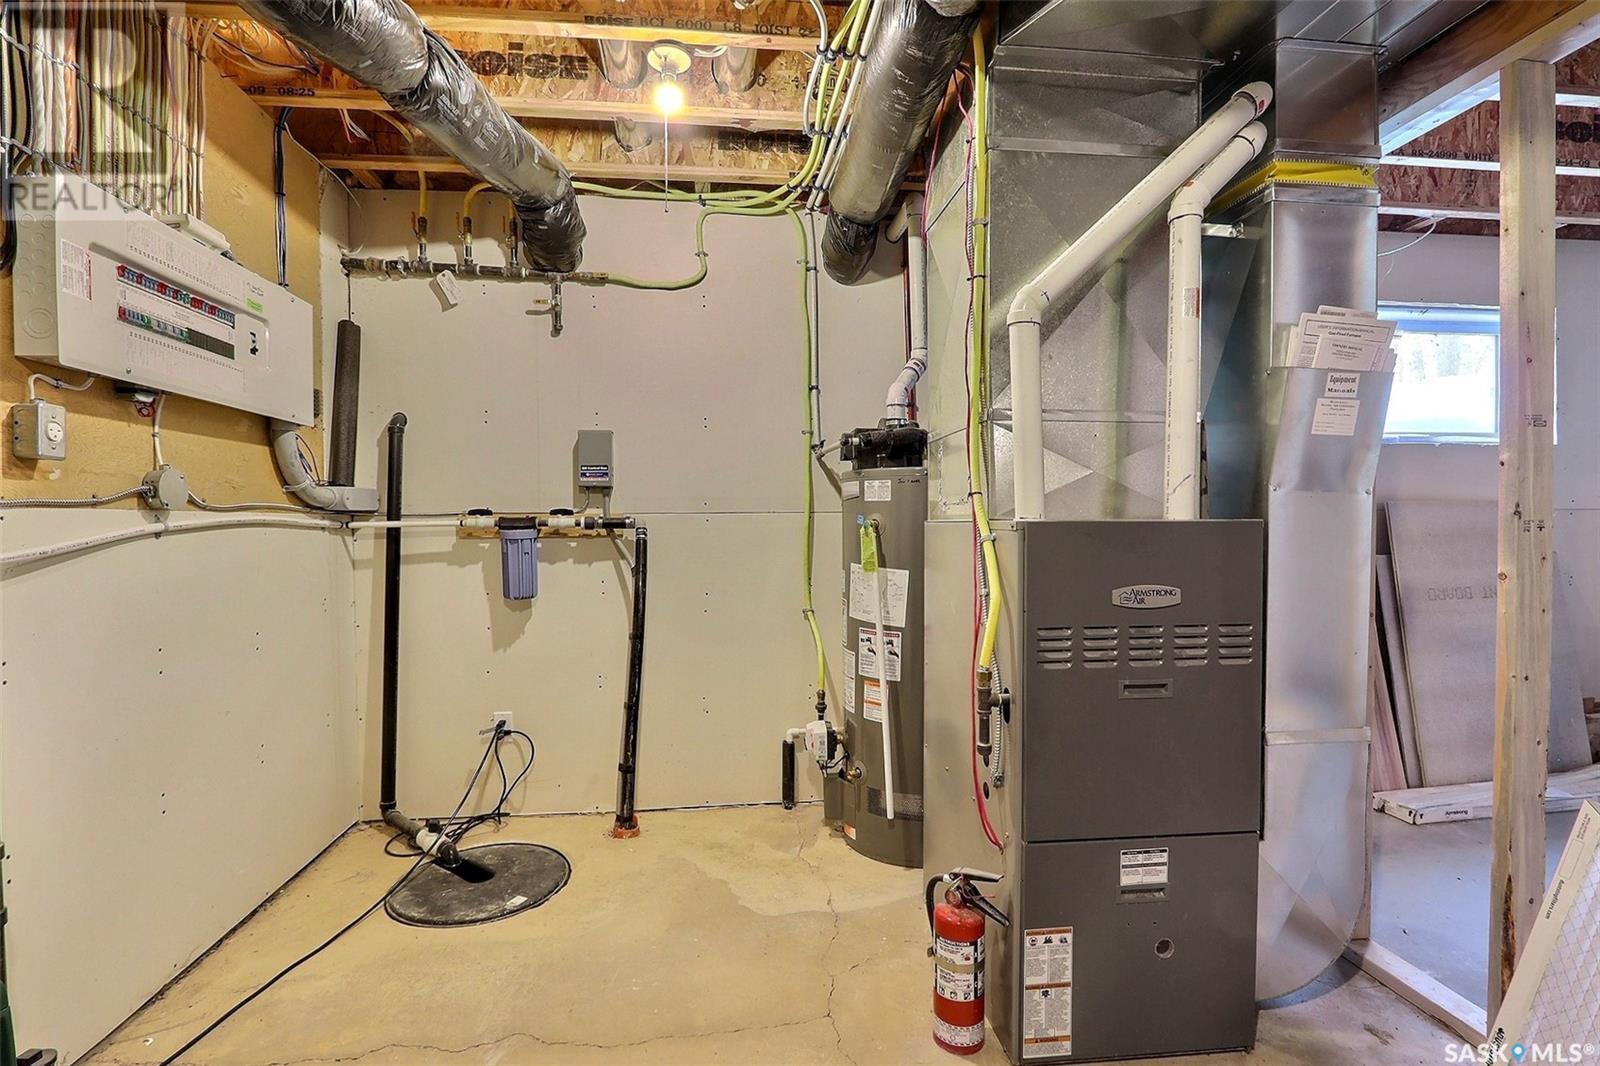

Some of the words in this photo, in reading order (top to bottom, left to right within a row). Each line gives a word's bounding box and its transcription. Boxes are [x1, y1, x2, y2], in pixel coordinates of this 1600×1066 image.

[676, 19, 712, 30] 6000
[752, 23, 792, 35] JOIST
[1130, 588, 1177, 597] ARMSTRONG
